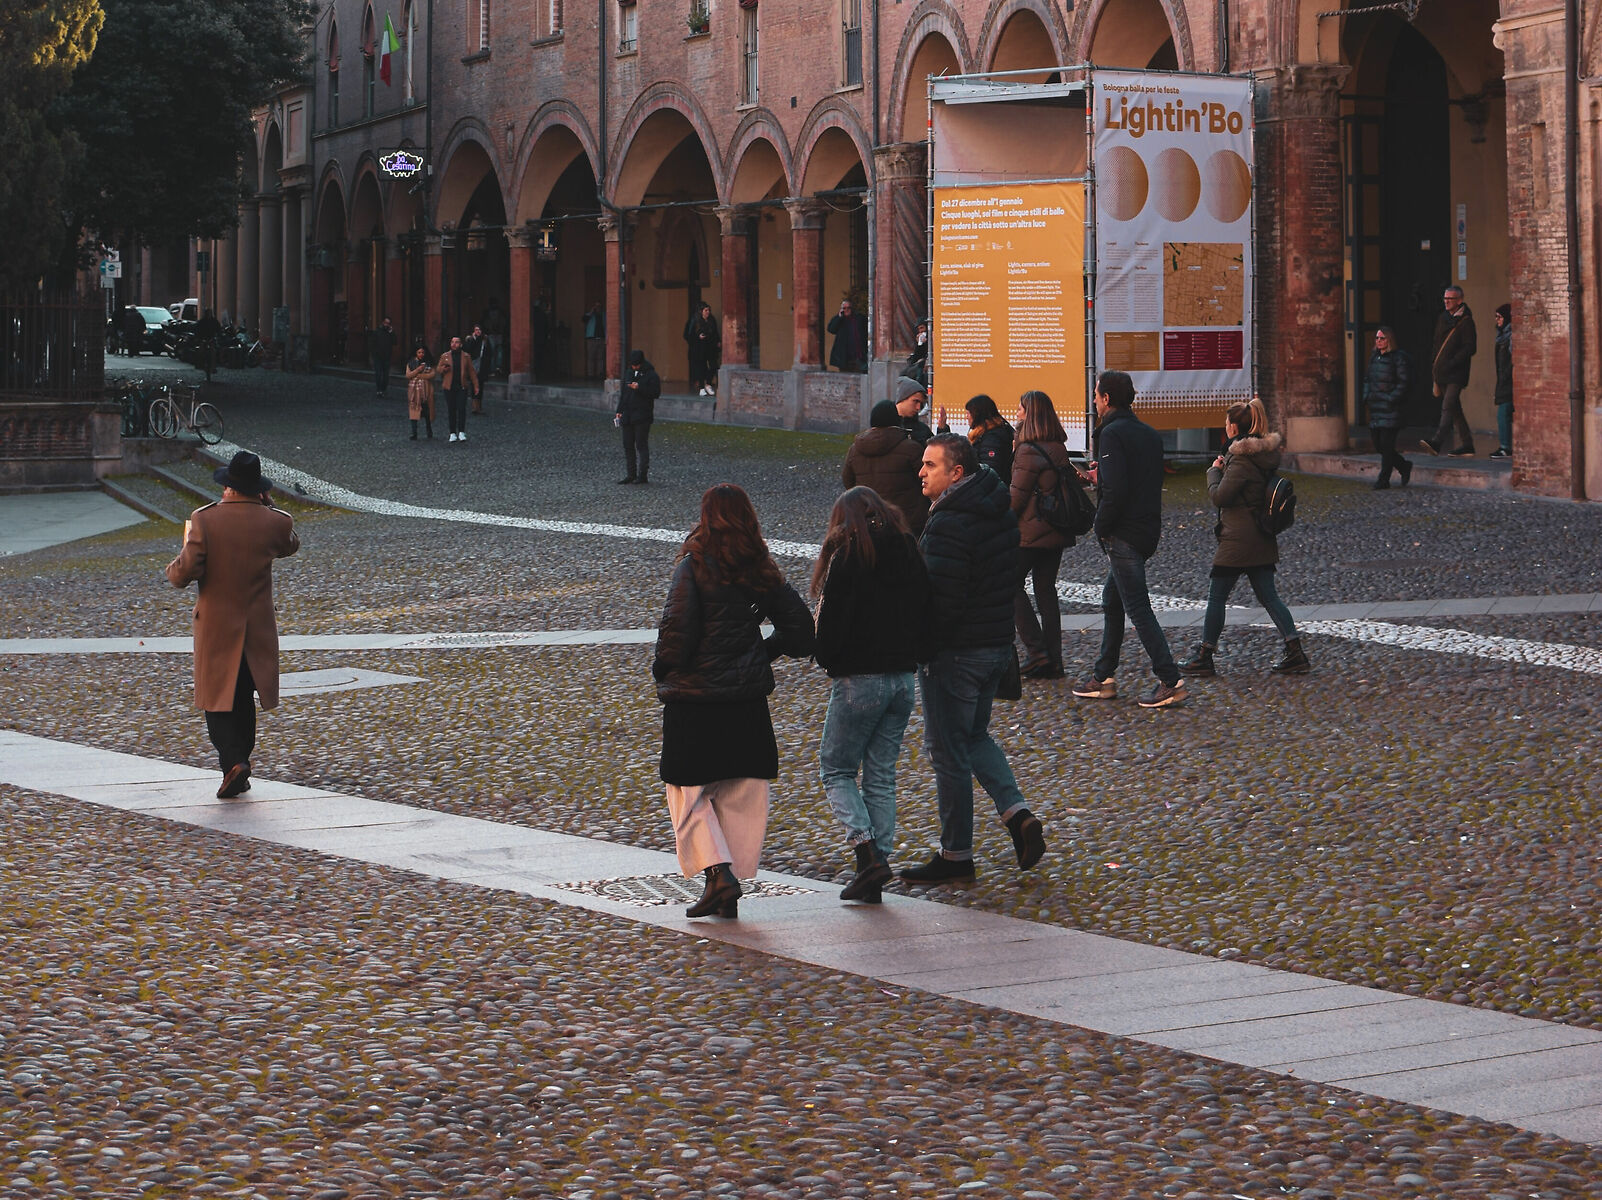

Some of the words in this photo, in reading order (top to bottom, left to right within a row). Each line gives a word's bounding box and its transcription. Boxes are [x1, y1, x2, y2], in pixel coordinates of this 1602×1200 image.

[1103, 83, 1128, 93] Bologna
[1129, 84, 1145, 92] balla
[1145, 86, 1156, 94] per
[1157, 85, 1163, 93] le
[1163, 86, 1180, 95] feste
[1105, 96, 1243, 138] Lightin'Bo
[386, 160, 416, 171] Cesarino
[941, 199, 951, 207] Dal
[951, 199, 959, 207] 27
[959, 198, 987, 207] dicembre
[999, 197, 1023, 207] gennaio
[941, 210, 961, 220] Cinque
[961, 209, 982, 219] luoghi,
[982, 209, 991, 217] sei
[992, 209, 1004, 217] film
[1008, 208, 1029, 218] cinque
[1029, 207, 1042, 216] stili
[1042, 207, 1049, 215] di
[1049, 207, 1065, 215] ballo
[941, 223, 951, 231] per
[971, 221, 978, 229] la
[978, 220, 992, 229] città
[992, 221, 1008, 229] sotto
[1009, 219, 1032, 228] un'altra
[1032, 219, 1046, 228] luce
